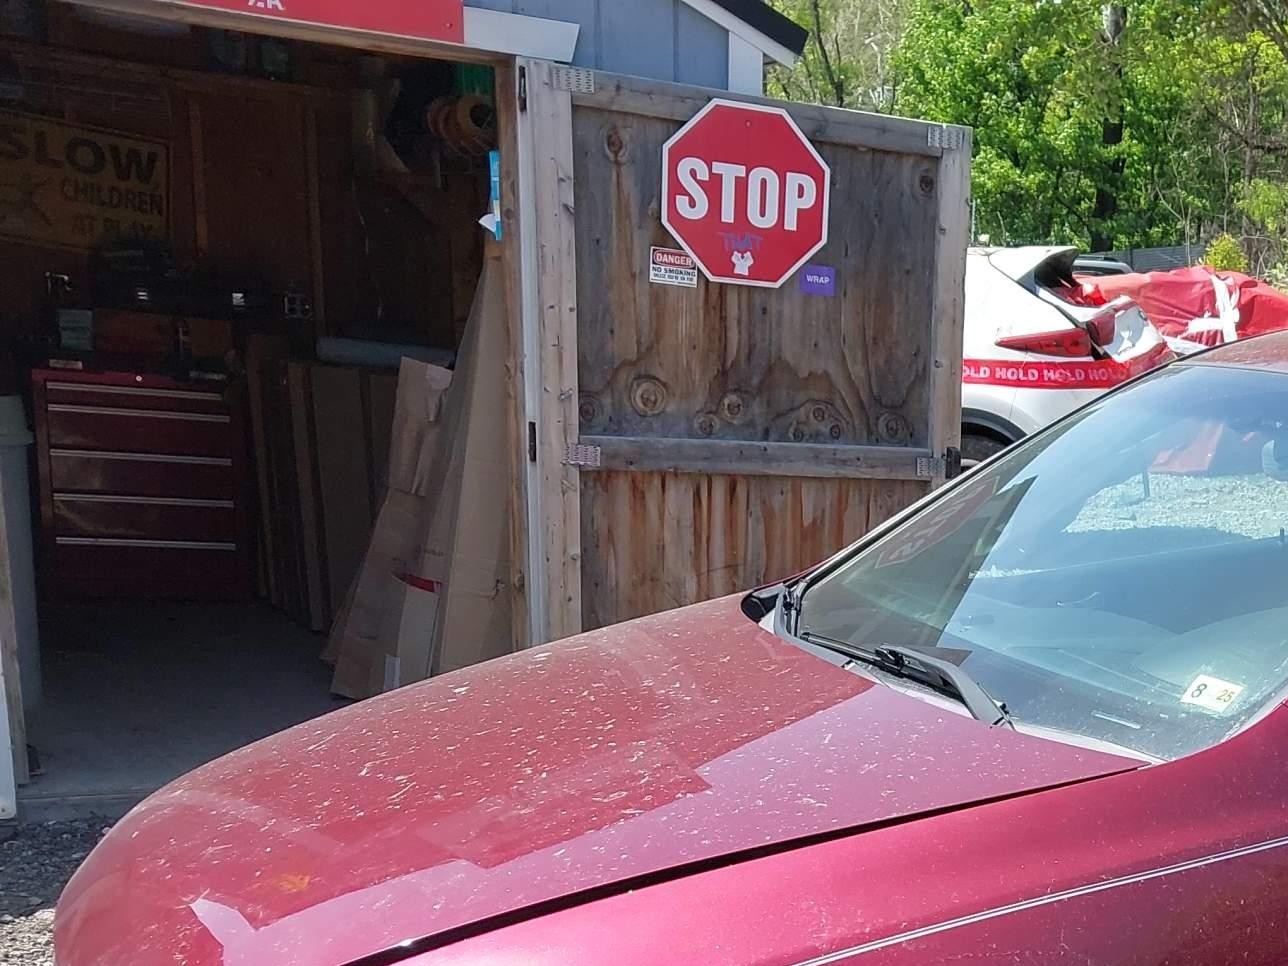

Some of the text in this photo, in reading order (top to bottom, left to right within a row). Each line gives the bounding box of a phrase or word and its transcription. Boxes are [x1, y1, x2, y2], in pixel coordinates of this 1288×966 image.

[0, 128, 159, 184] SLOW
[60, 177, 164, 216] CHILDREN
[675, 156, 817, 231] STOP
[72, 212, 97, 236] AT
[655, 252, 692, 266] DANGER
[664, 268, 696, 277] SMOKING
[806, 274, 830, 284] WRAP
[963, 365, 990, 378] OLD
[995, 367, 1038, 381] HOLD
